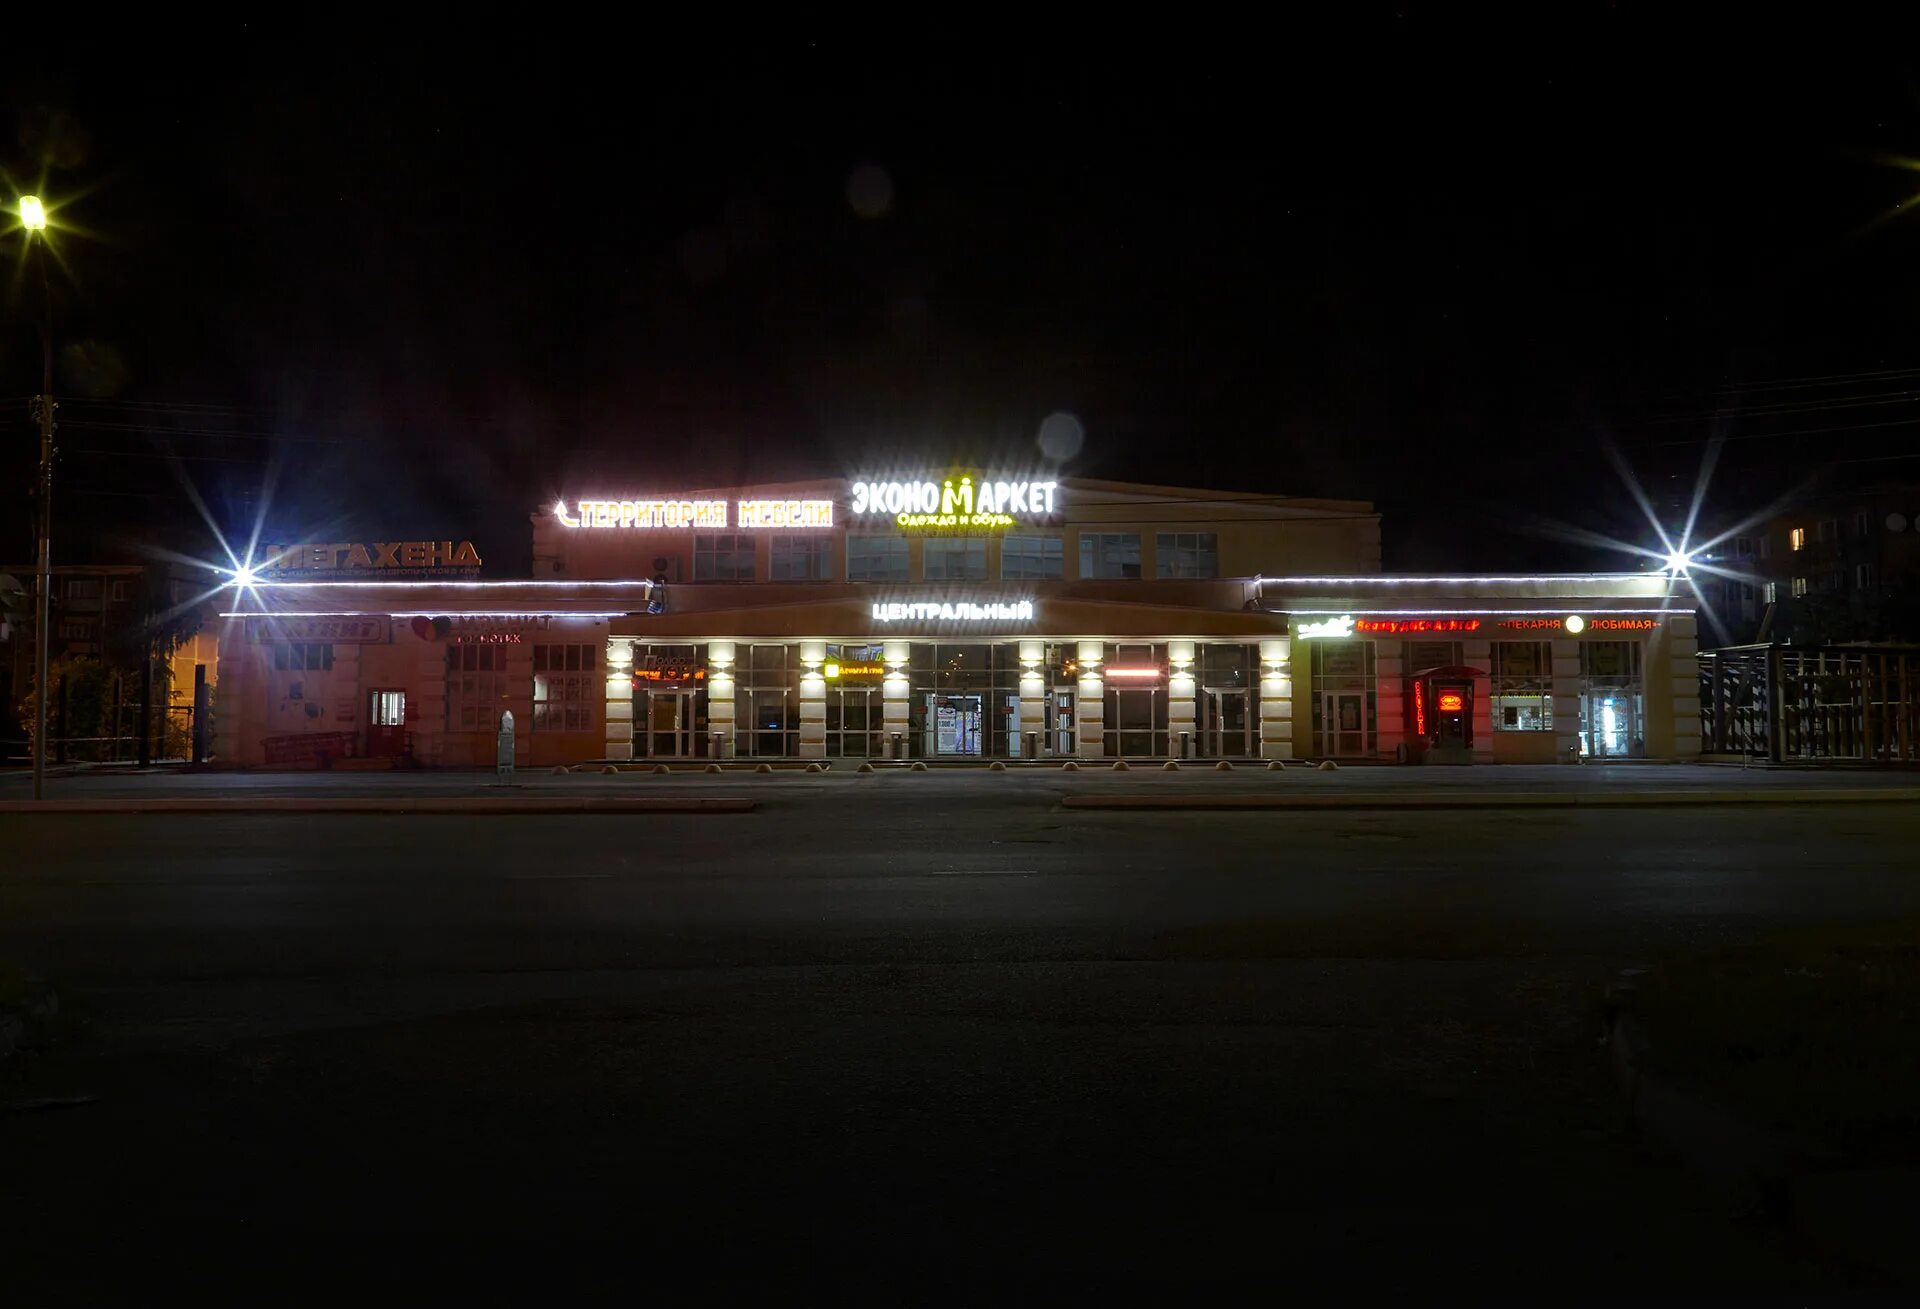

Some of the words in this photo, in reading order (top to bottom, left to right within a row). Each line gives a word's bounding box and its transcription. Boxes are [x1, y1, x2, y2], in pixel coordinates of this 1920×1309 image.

[578, 500, 728, 528] ТЕРРИТОРИЯ
[738, 500, 834, 528] МЕБЕЛИ
[897, 513, 956, 527] Одежда
[960, 515, 968, 525] и
[971, 512, 1013, 527] обувь
[265, 540, 483, 568] МЕГАХЕНД
[872, 600, 1033, 623] ЦЕНТРАЛЬНЫЙ
[1507, 619, 1560, 630] ПЕКАРНЯ
[1590, 619, 1652, 630] ЛЮБИМАЯ
